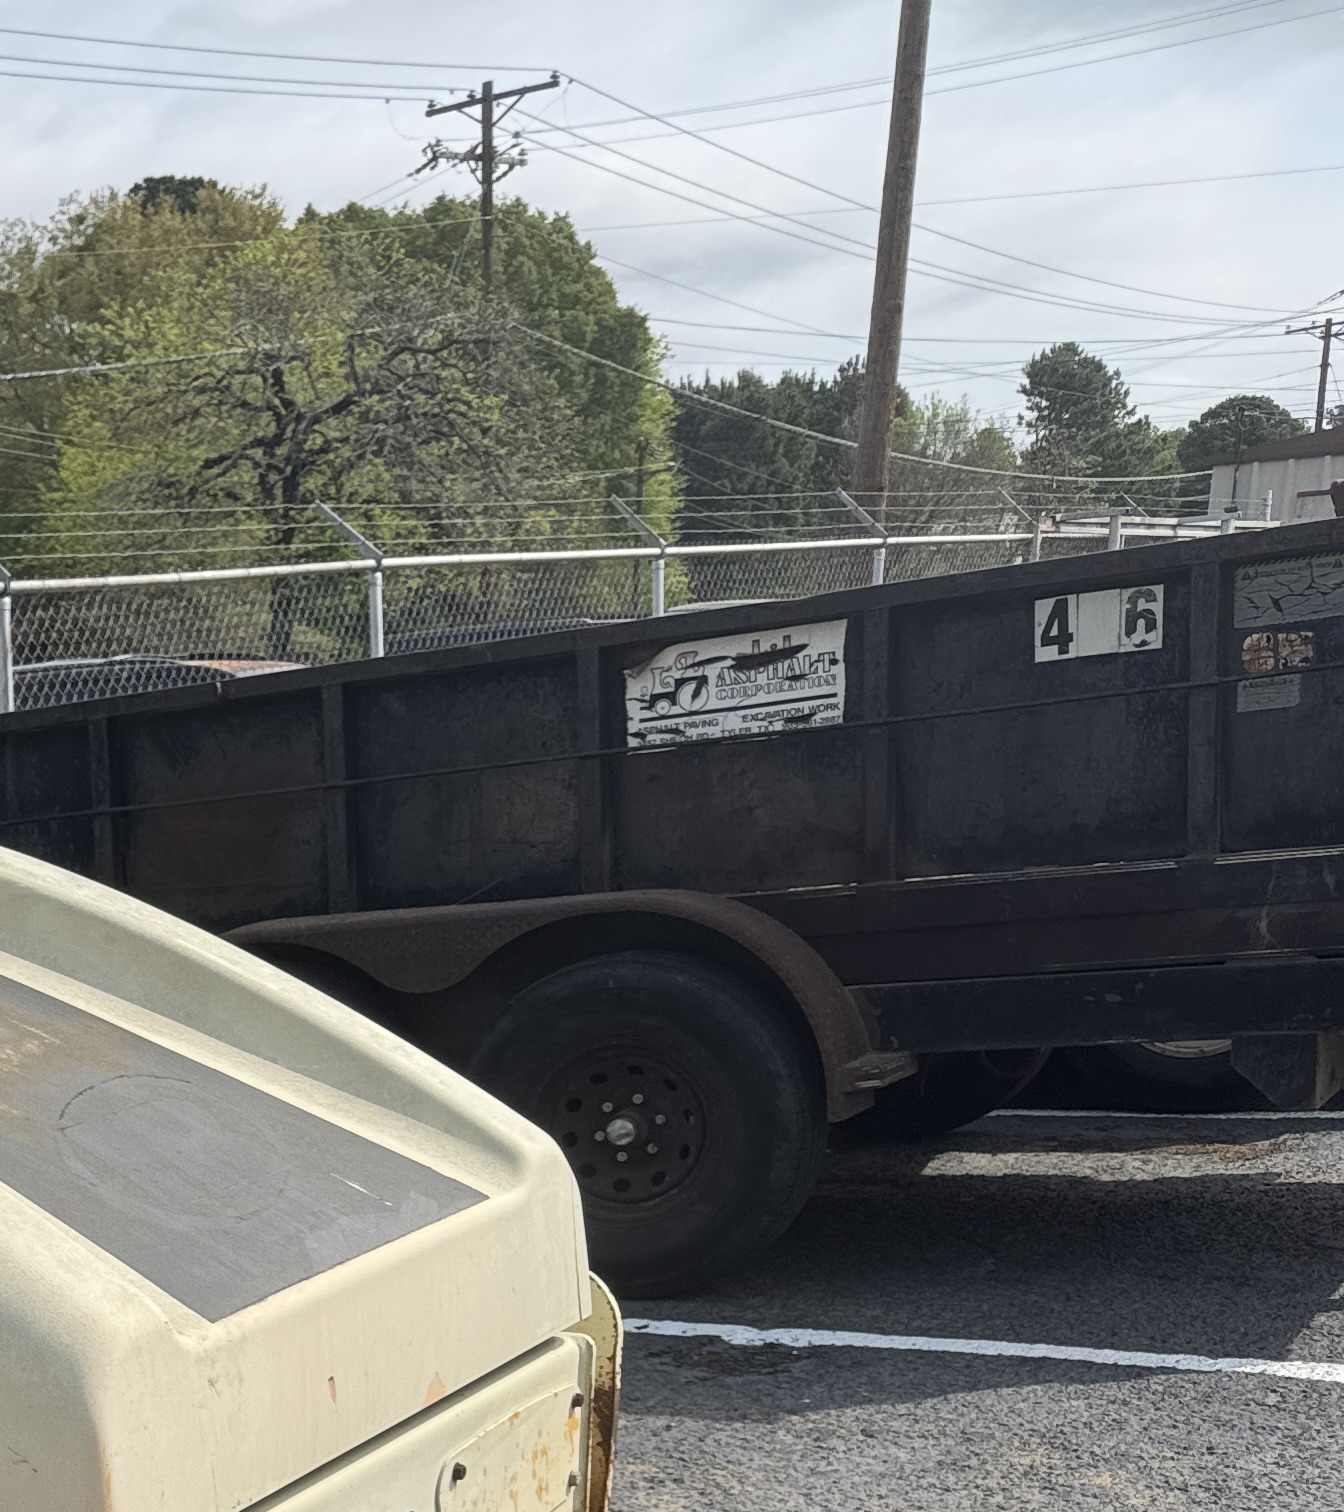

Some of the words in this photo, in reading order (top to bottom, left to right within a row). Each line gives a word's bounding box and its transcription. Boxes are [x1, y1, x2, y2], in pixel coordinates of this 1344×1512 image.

[1040, 597, 1074, 656] 4
[1124, 588, 1158, 648] 6
[715, 651, 836, 688] ASPHALT
[715, 673, 837, 700] CORPORATION
[683, 718, 719, 730] PAVING
[741, 706, 805, 723] EXCAVATION
[808, 702, 841, 714] WORK
